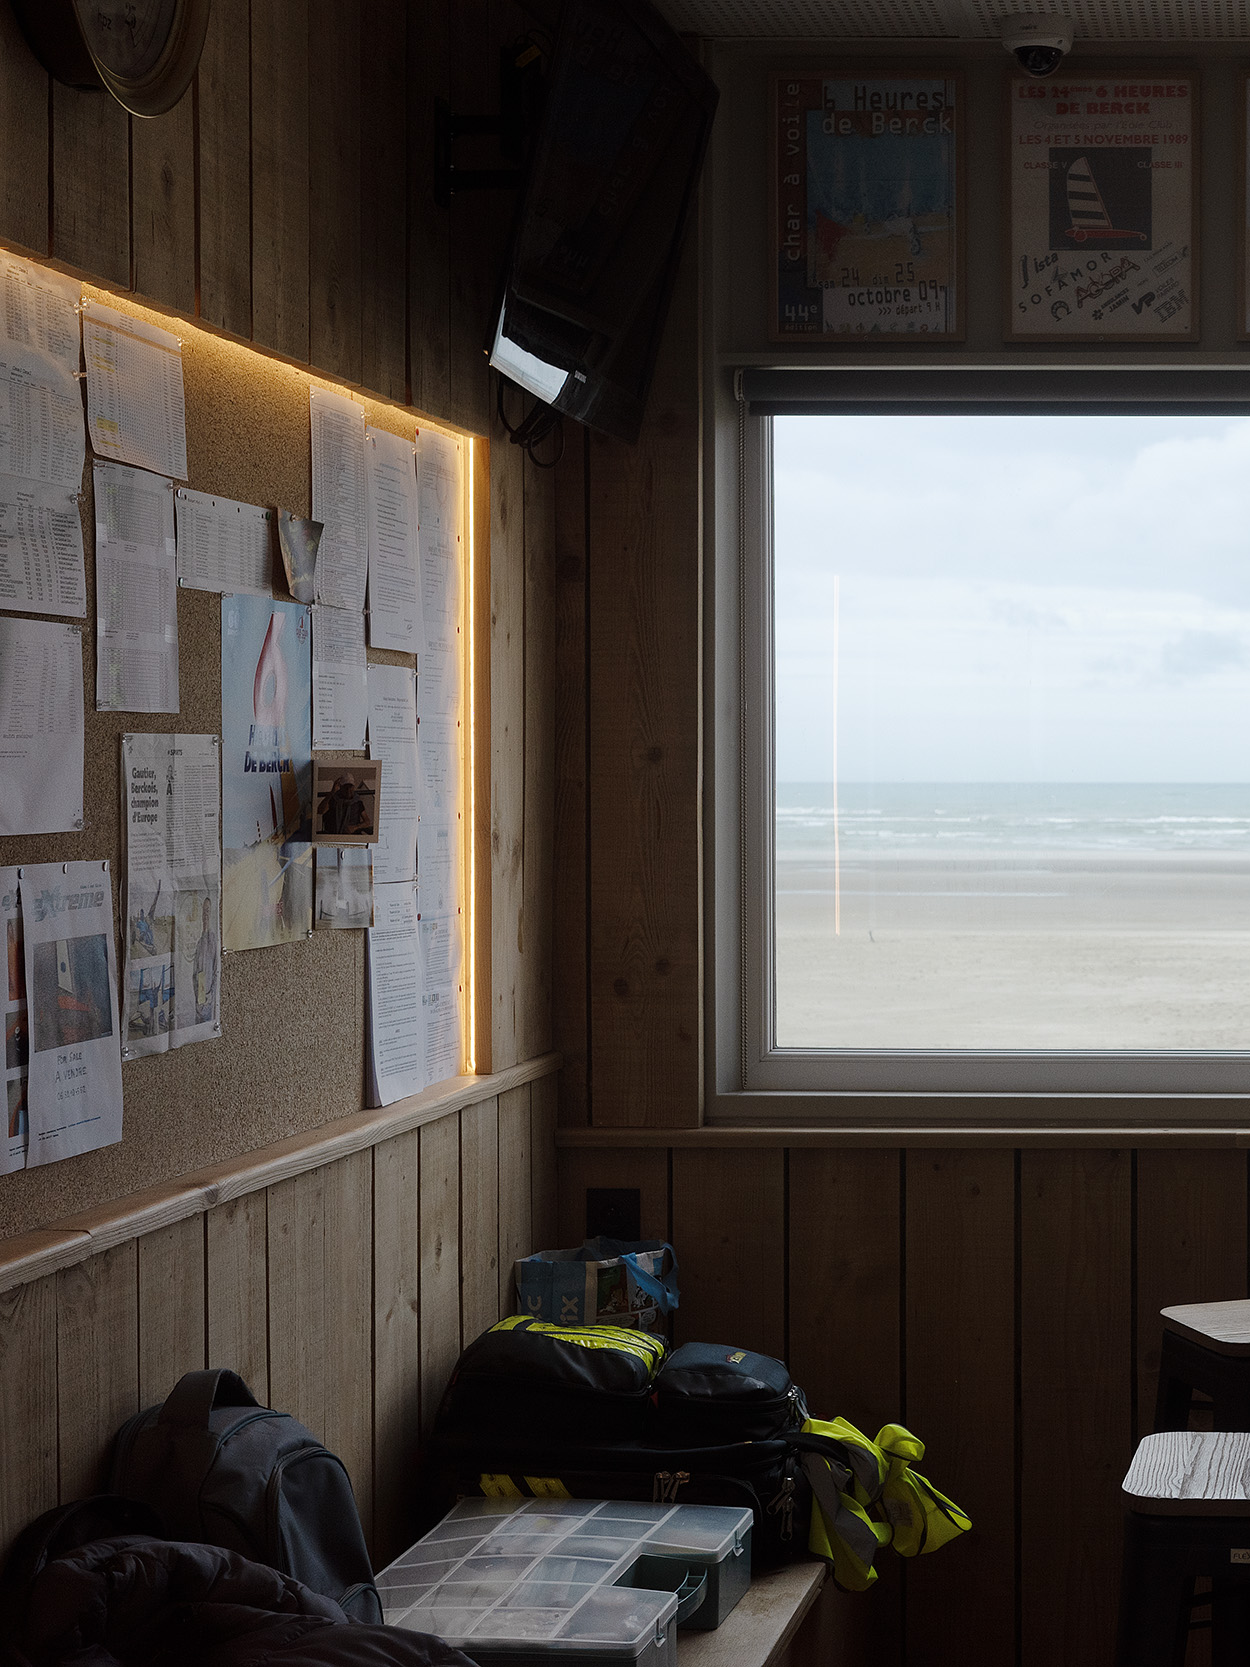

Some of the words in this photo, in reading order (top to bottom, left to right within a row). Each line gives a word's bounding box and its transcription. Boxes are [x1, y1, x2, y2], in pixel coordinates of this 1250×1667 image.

[1018, 85, 1047, 98] LES
[1096, 84, 1108, 98] 6
[1114, 85, 1188, 98] HEURES
[854, 86, 944, 111] Heures
[1056, 102, 1080, 115] DE
[1086, 102, 1150, 115] BERCK
[822, 112, 852, 135] de
[871, 112, 953, 135] Berck
[1019, 135, 1042, 145] LES
[1045, 135, 1051, 145] 4
[1055, 135, 1071, 145] ET
[1074, 135, 1081, 145] 5
[1084, 134, 1159, 145] NOVEMBRE
[1163, 134, 1188, 145] 1989
[1023, 161, 1059, 169] CLASSE
[1137, 161, 1172, 169] CLASSE
[783, 203, 800, 262] char
[895, 262, 915, 284] 25
[847, 286, 911, 307] octobre
[131, 767, 157, 780] Gautier,
[130, 782, 159, 795] Berckois,
[130, 797, 159, 811] champion
[131, 812, 158, 825] d'Europe
